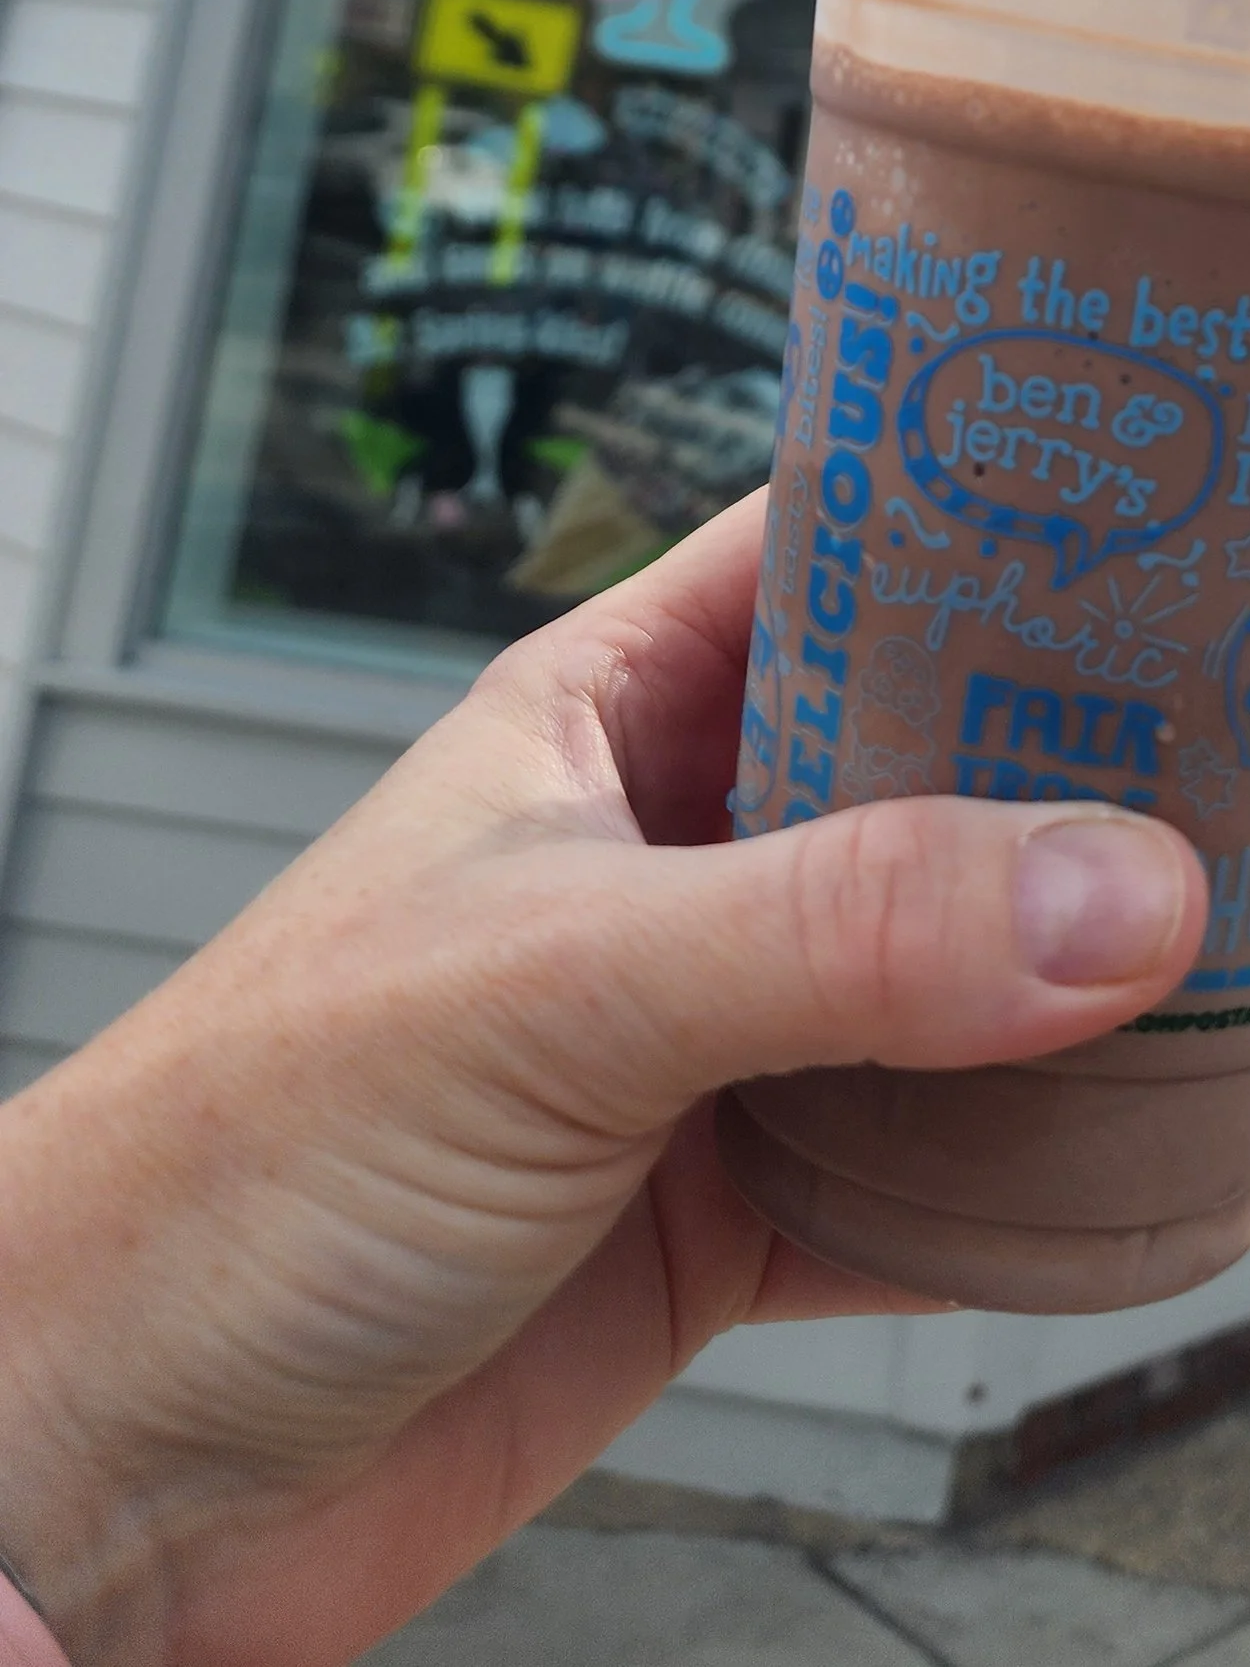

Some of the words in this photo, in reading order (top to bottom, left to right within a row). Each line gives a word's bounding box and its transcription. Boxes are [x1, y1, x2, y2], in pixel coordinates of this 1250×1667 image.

[1017, 254, 1110, 331] the
[977, 353, 1101, 430] ben
[1111, 394, 1184, 448] &
[937, 399, 1158, 517] jerry's
[872, 561, 1178, 688] euphoric
[959, 671, 1166, 776] FAIR
